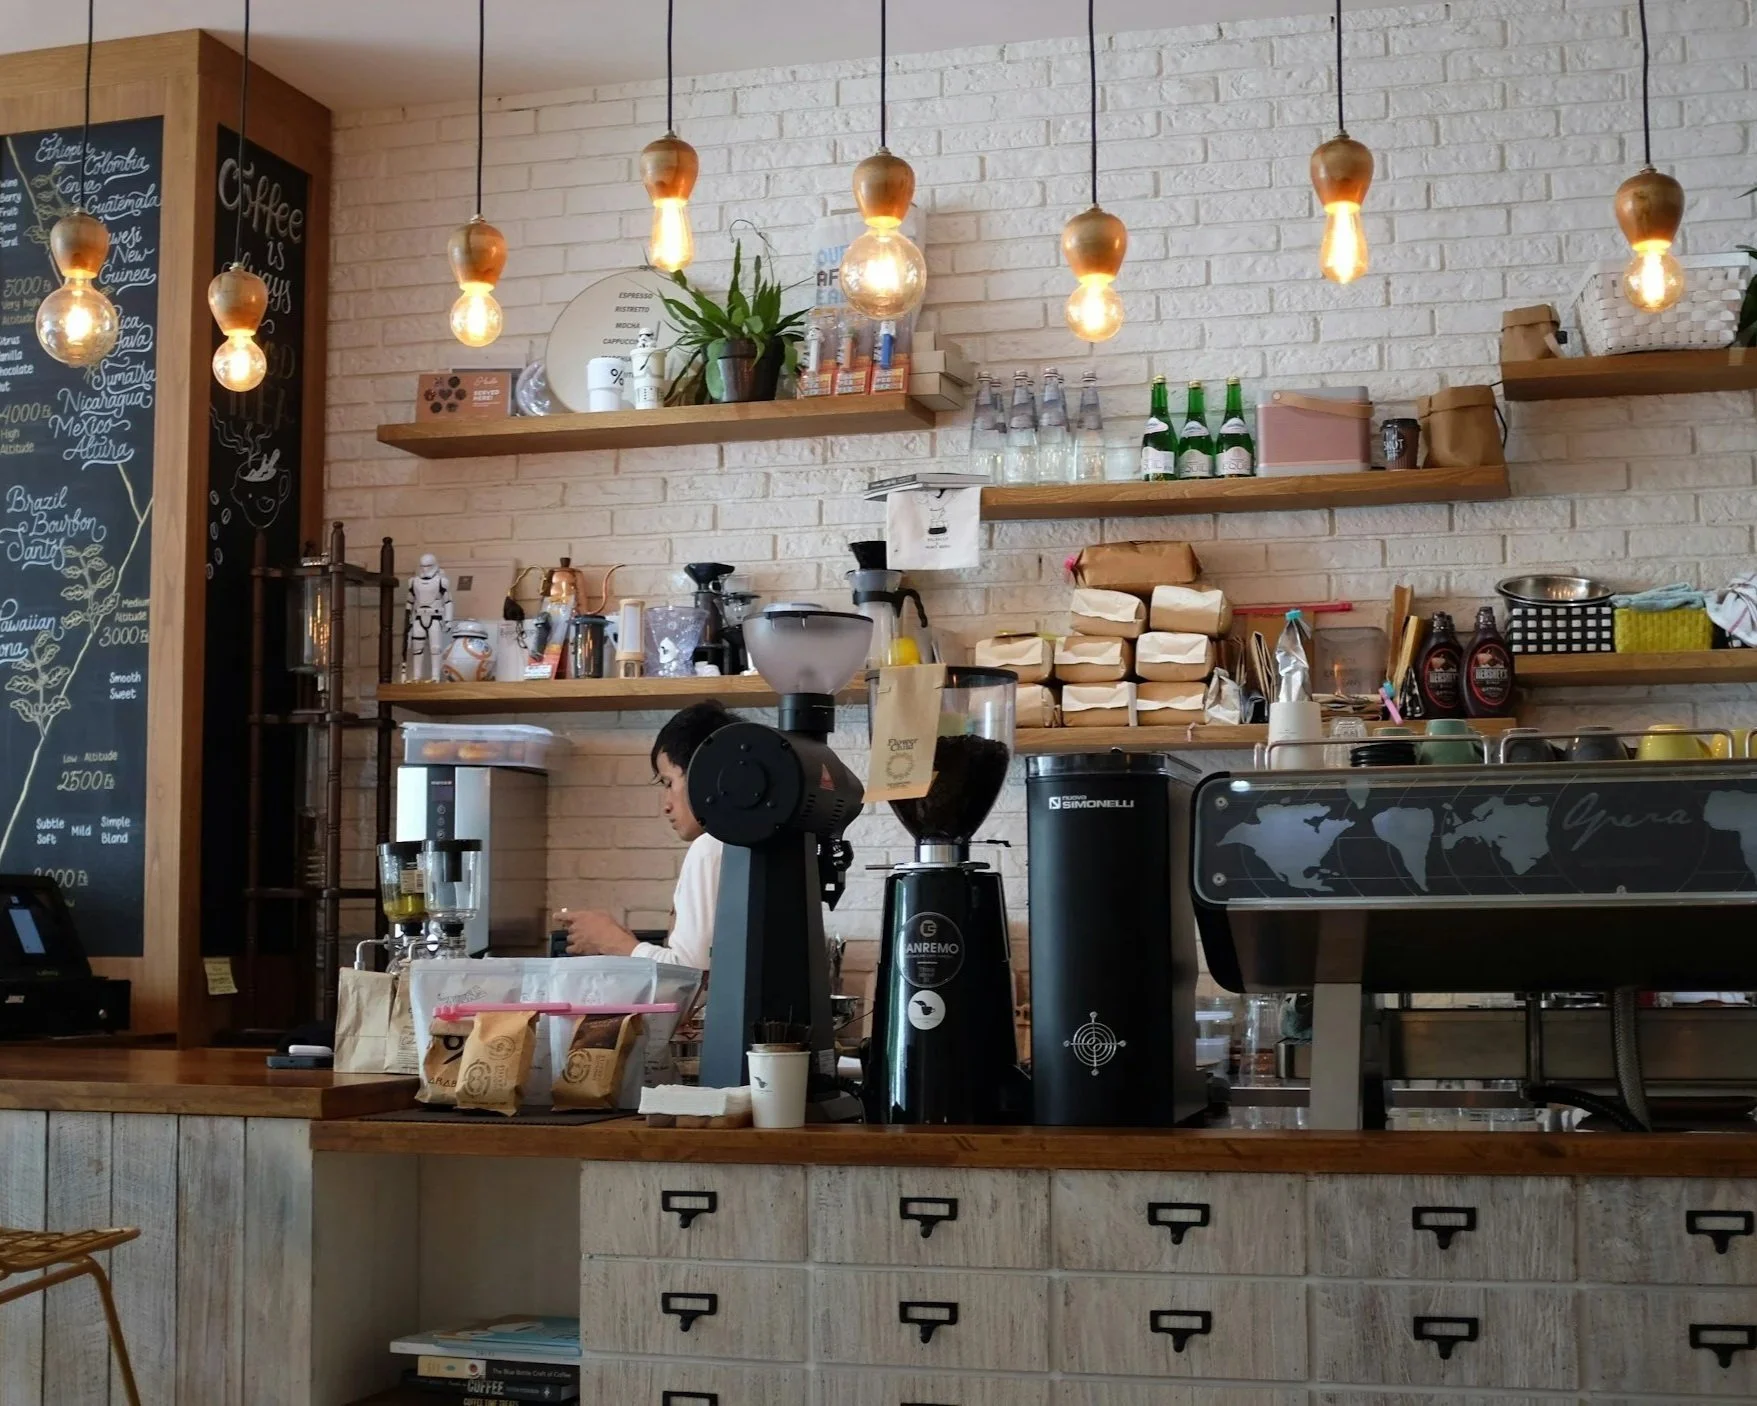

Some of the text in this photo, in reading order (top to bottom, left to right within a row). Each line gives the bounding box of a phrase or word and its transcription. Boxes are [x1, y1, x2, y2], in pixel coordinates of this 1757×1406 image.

[84, 147, 149, 184] Colombia
[85, 183, 161, 220] Guatemala
[111, 244, 155, 264] New
[267, 237, 285, 272] is
[99, 263, 157, 293] Guinea
[618, 292, 654, 300] ESPRESSO
[92, 357, 157, 394] Sumatra
[57, 388, 152, 418] Nicaragua
[49, 414, 131, 438] Mexico
[62, 433, 134, 470] Altura
[6, 485, 68, 516] Brazil
[29, 508, 107, 542] Bourbon
[0, 521, 65, 570] Santos
[0, 642, 28, 662] ona
[109, 671, 141, 684] Smooth
[109, 687, 137, 700] Sweet
[1062, 800, 1135, 809] SIMONELLI
[36, 817, 65, 830] Subtle
[71, 824, 92, 837] Mild
[101, 815, 131, 829] Simple
[1561, 792, 1693, 852] Opera
[36, 832, 57, 845] Soft
[101, 831, 129, 845] Bland
[467, 1380, 504, 1395] COFFEE
